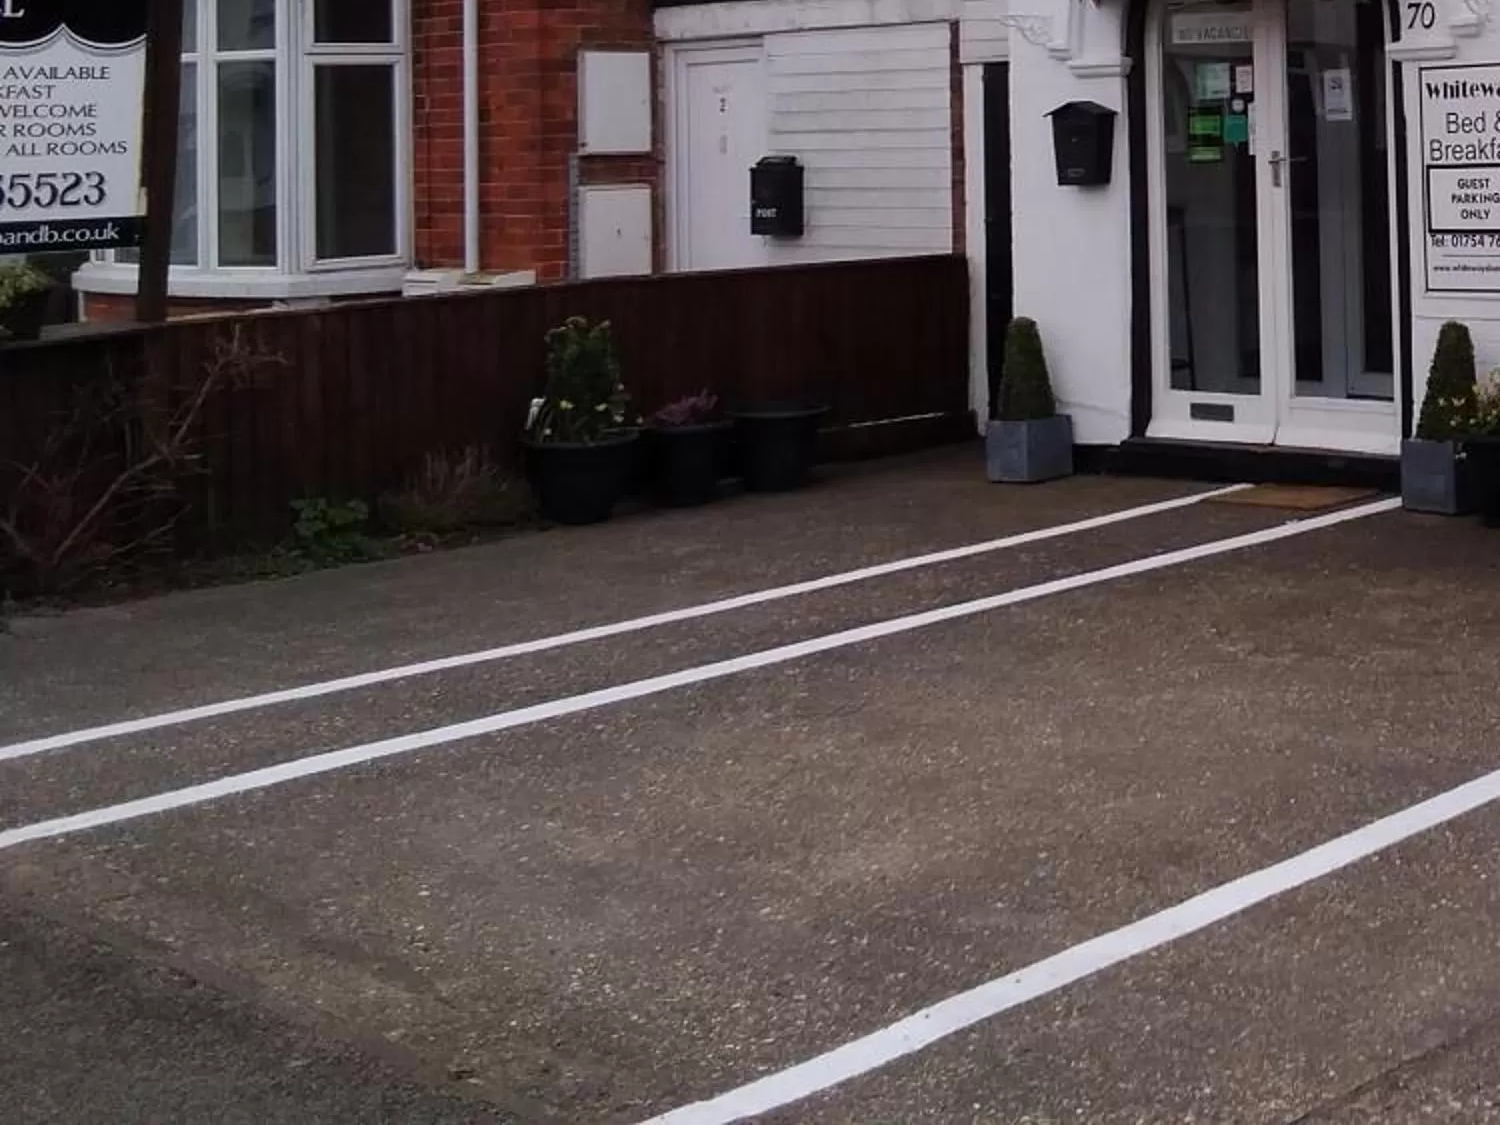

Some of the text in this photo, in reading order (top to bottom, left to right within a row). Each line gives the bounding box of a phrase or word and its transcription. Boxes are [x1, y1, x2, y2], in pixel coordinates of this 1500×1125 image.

[1407, 1, 1435, 30] 70
[3, 66, 111, 80] AVAILABLE
[13, 122, 97, 138] ROOMS
[1446, 110, 1486, 134] Bed
[6, 140, 128, 156] ALL ROOMS
[0, 171, 106, 209] 5523
[1457, 178, 1490, 190] GUEST
[1451, 192, 1500, 204] PARKING
[1460, 208, 1491, 220] ONLY
[0, 222, 120, 246] andb.co.uk
[1451, 235, 1485, 248] 01754
